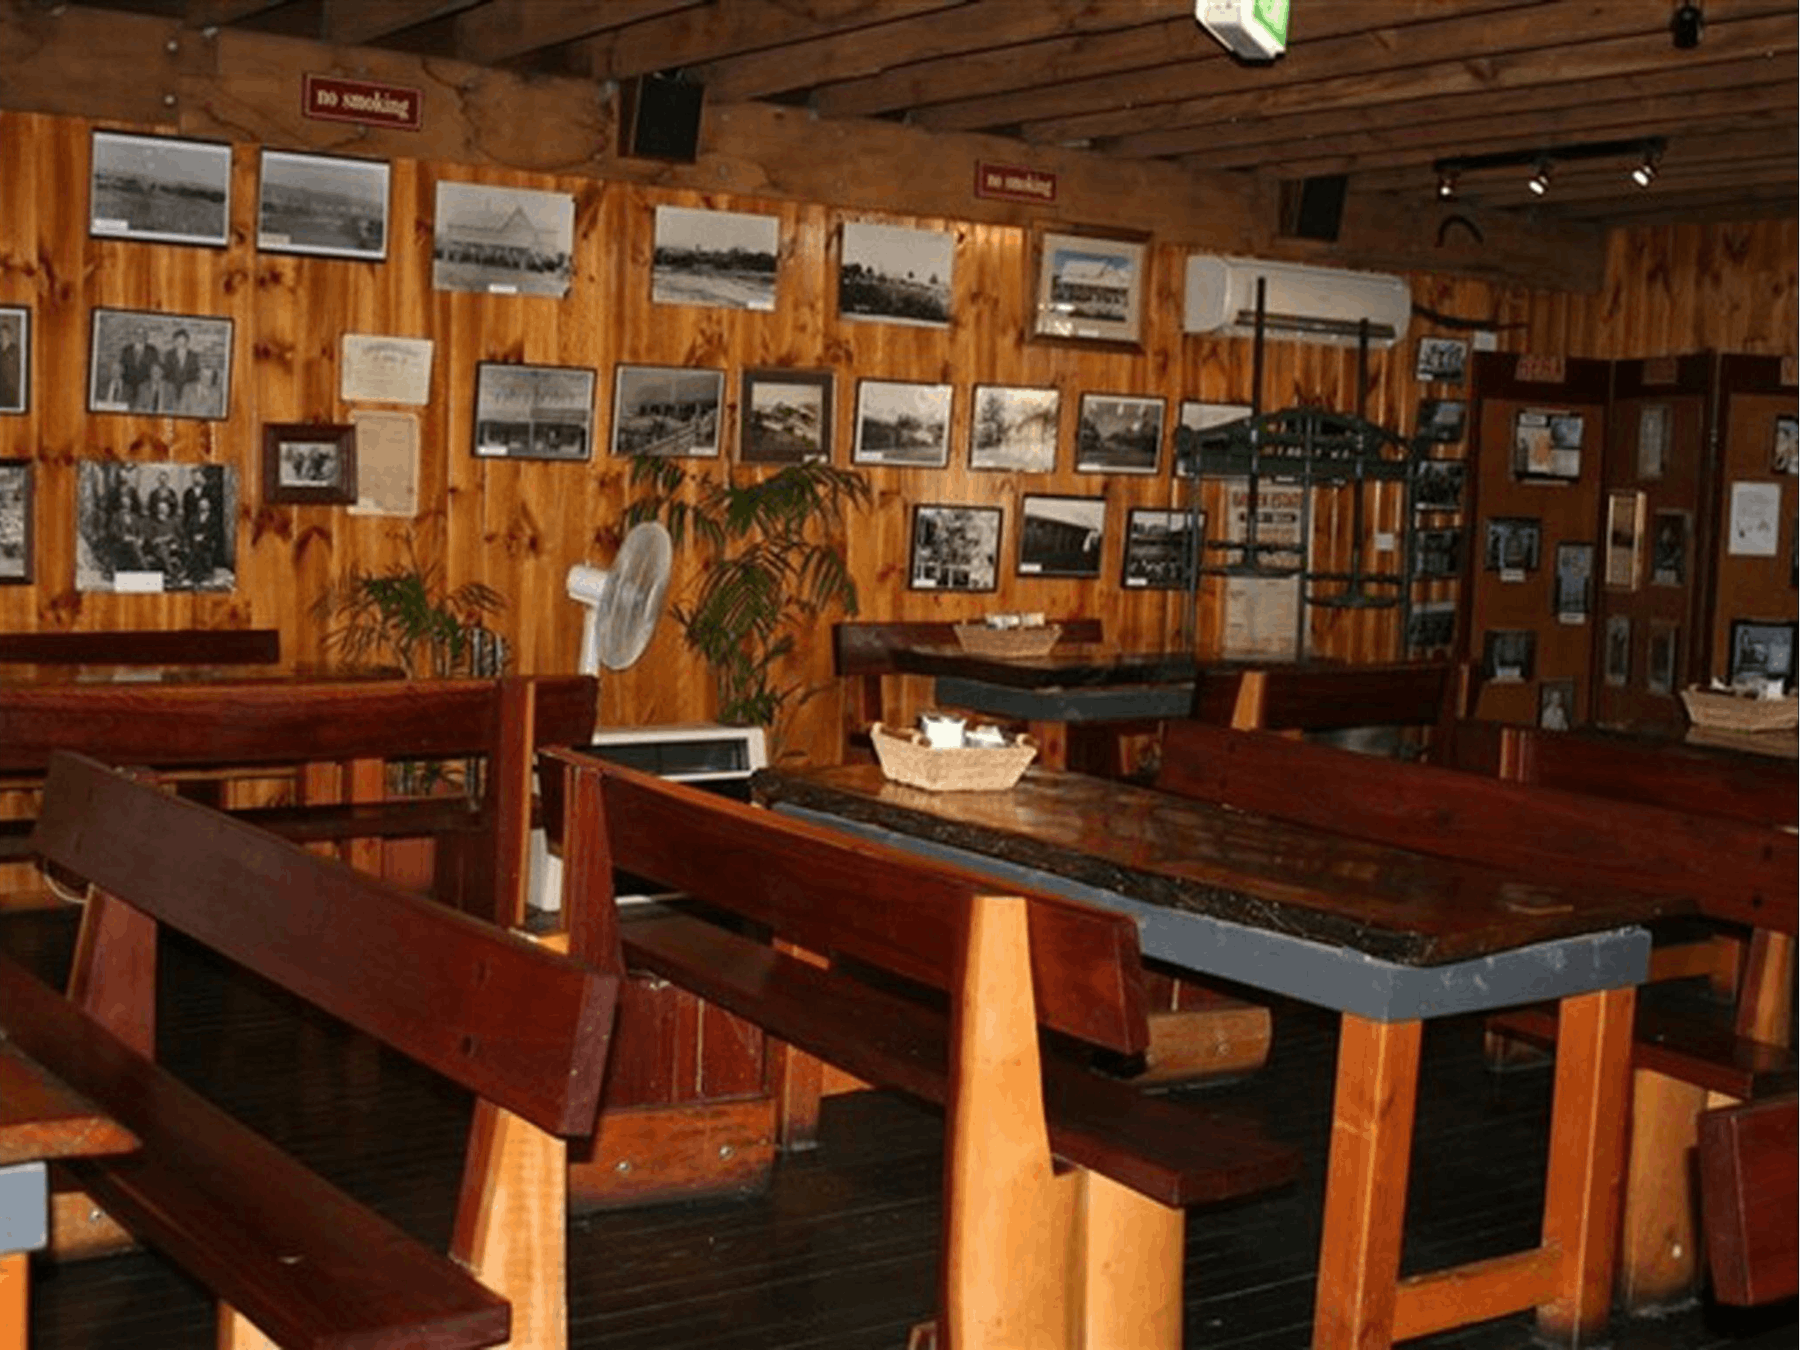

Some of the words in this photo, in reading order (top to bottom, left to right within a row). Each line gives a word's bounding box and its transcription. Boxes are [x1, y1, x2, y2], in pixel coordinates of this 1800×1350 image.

[317, 89, 339, 107] no
[342, 91, 409, 119] smoking
[1005, 173, 1053, 198] smoking
